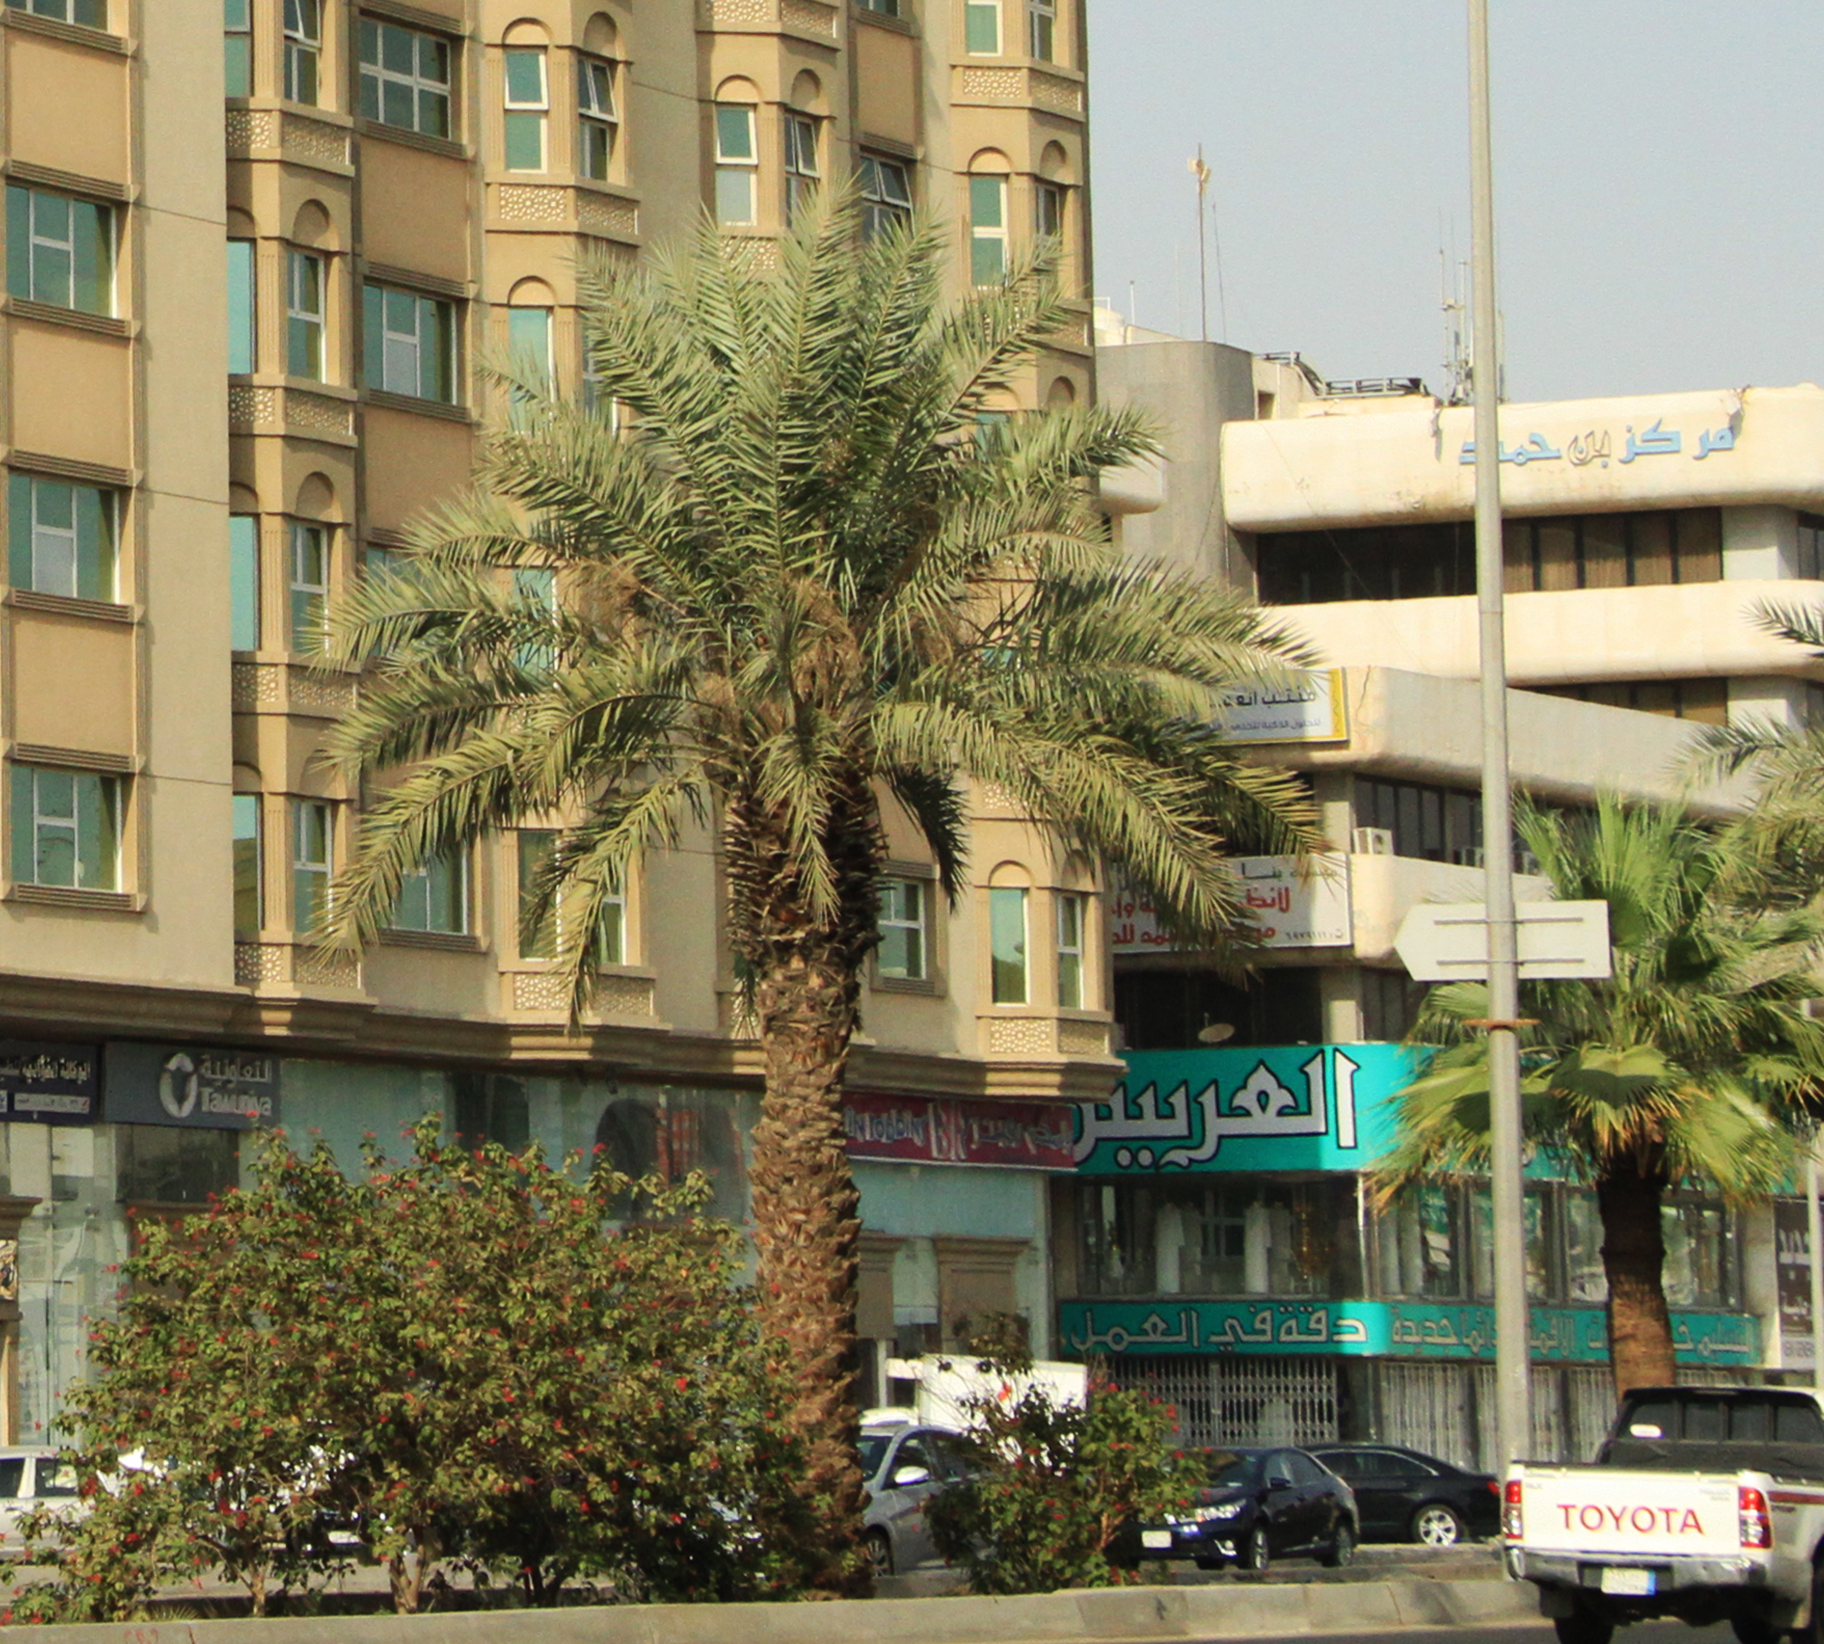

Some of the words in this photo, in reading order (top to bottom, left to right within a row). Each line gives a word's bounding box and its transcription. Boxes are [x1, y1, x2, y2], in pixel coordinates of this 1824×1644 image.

[1070, 1308, 1201, 1353] العمل
[1207, 1305, 1274, 1353] في
[1277, 1305, 1369, 1344] دقة
[1556, 1502, 1706, 1535] TOYOTA
